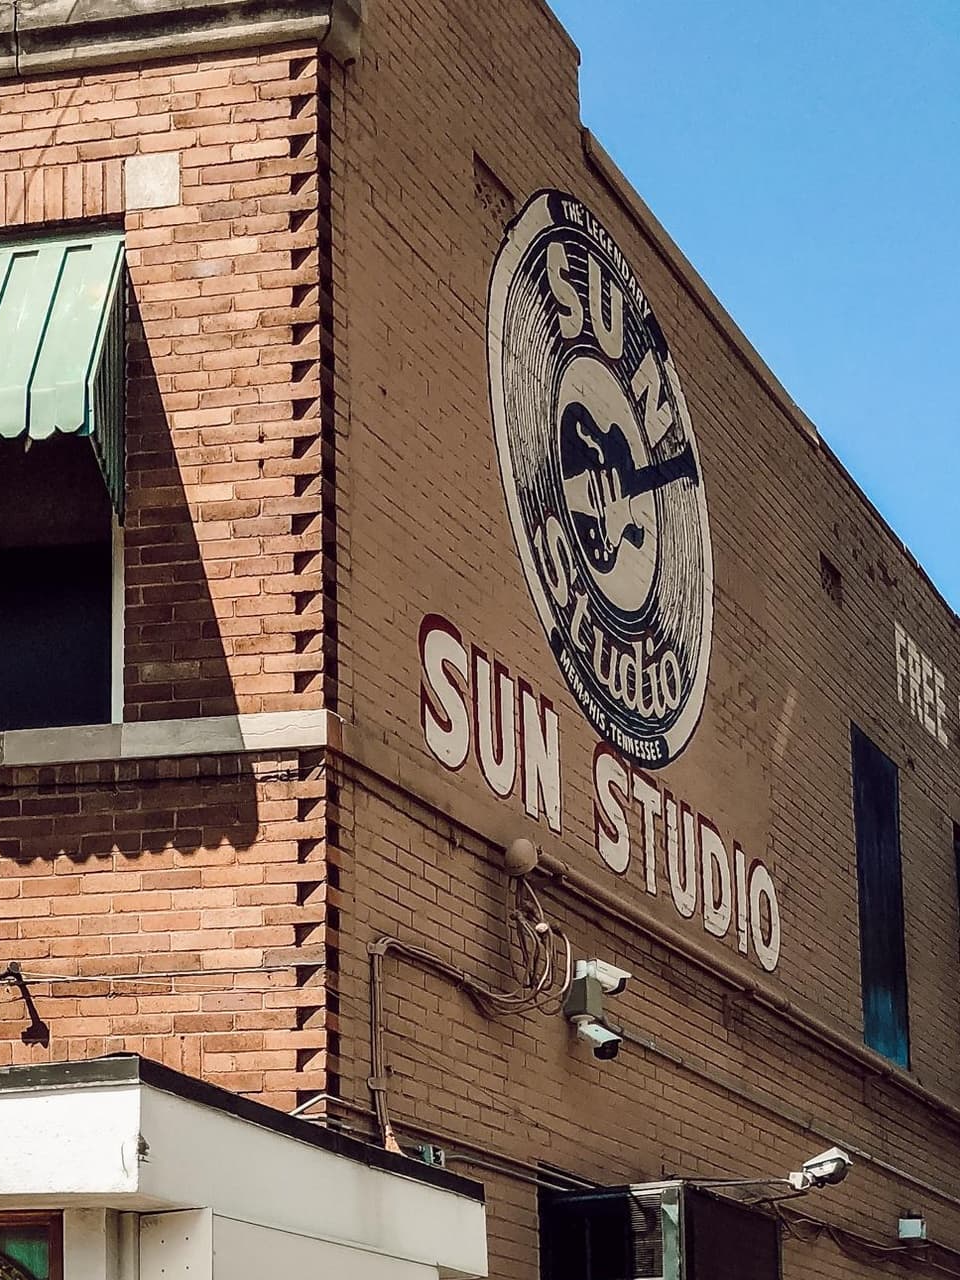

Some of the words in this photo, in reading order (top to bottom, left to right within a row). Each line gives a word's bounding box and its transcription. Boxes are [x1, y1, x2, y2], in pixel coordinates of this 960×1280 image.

[546, 241, 674, 448] SUN
[560, 200, 585, 227] THE
[585, 210, 652, 319] LEGENDARY
[535, 511, 682, 719] Studio
[419, 613, 563, 835] SUN
[593, 741, 781, 973] STUDIO
[609, 721, 663, 761] TENNESSEE
